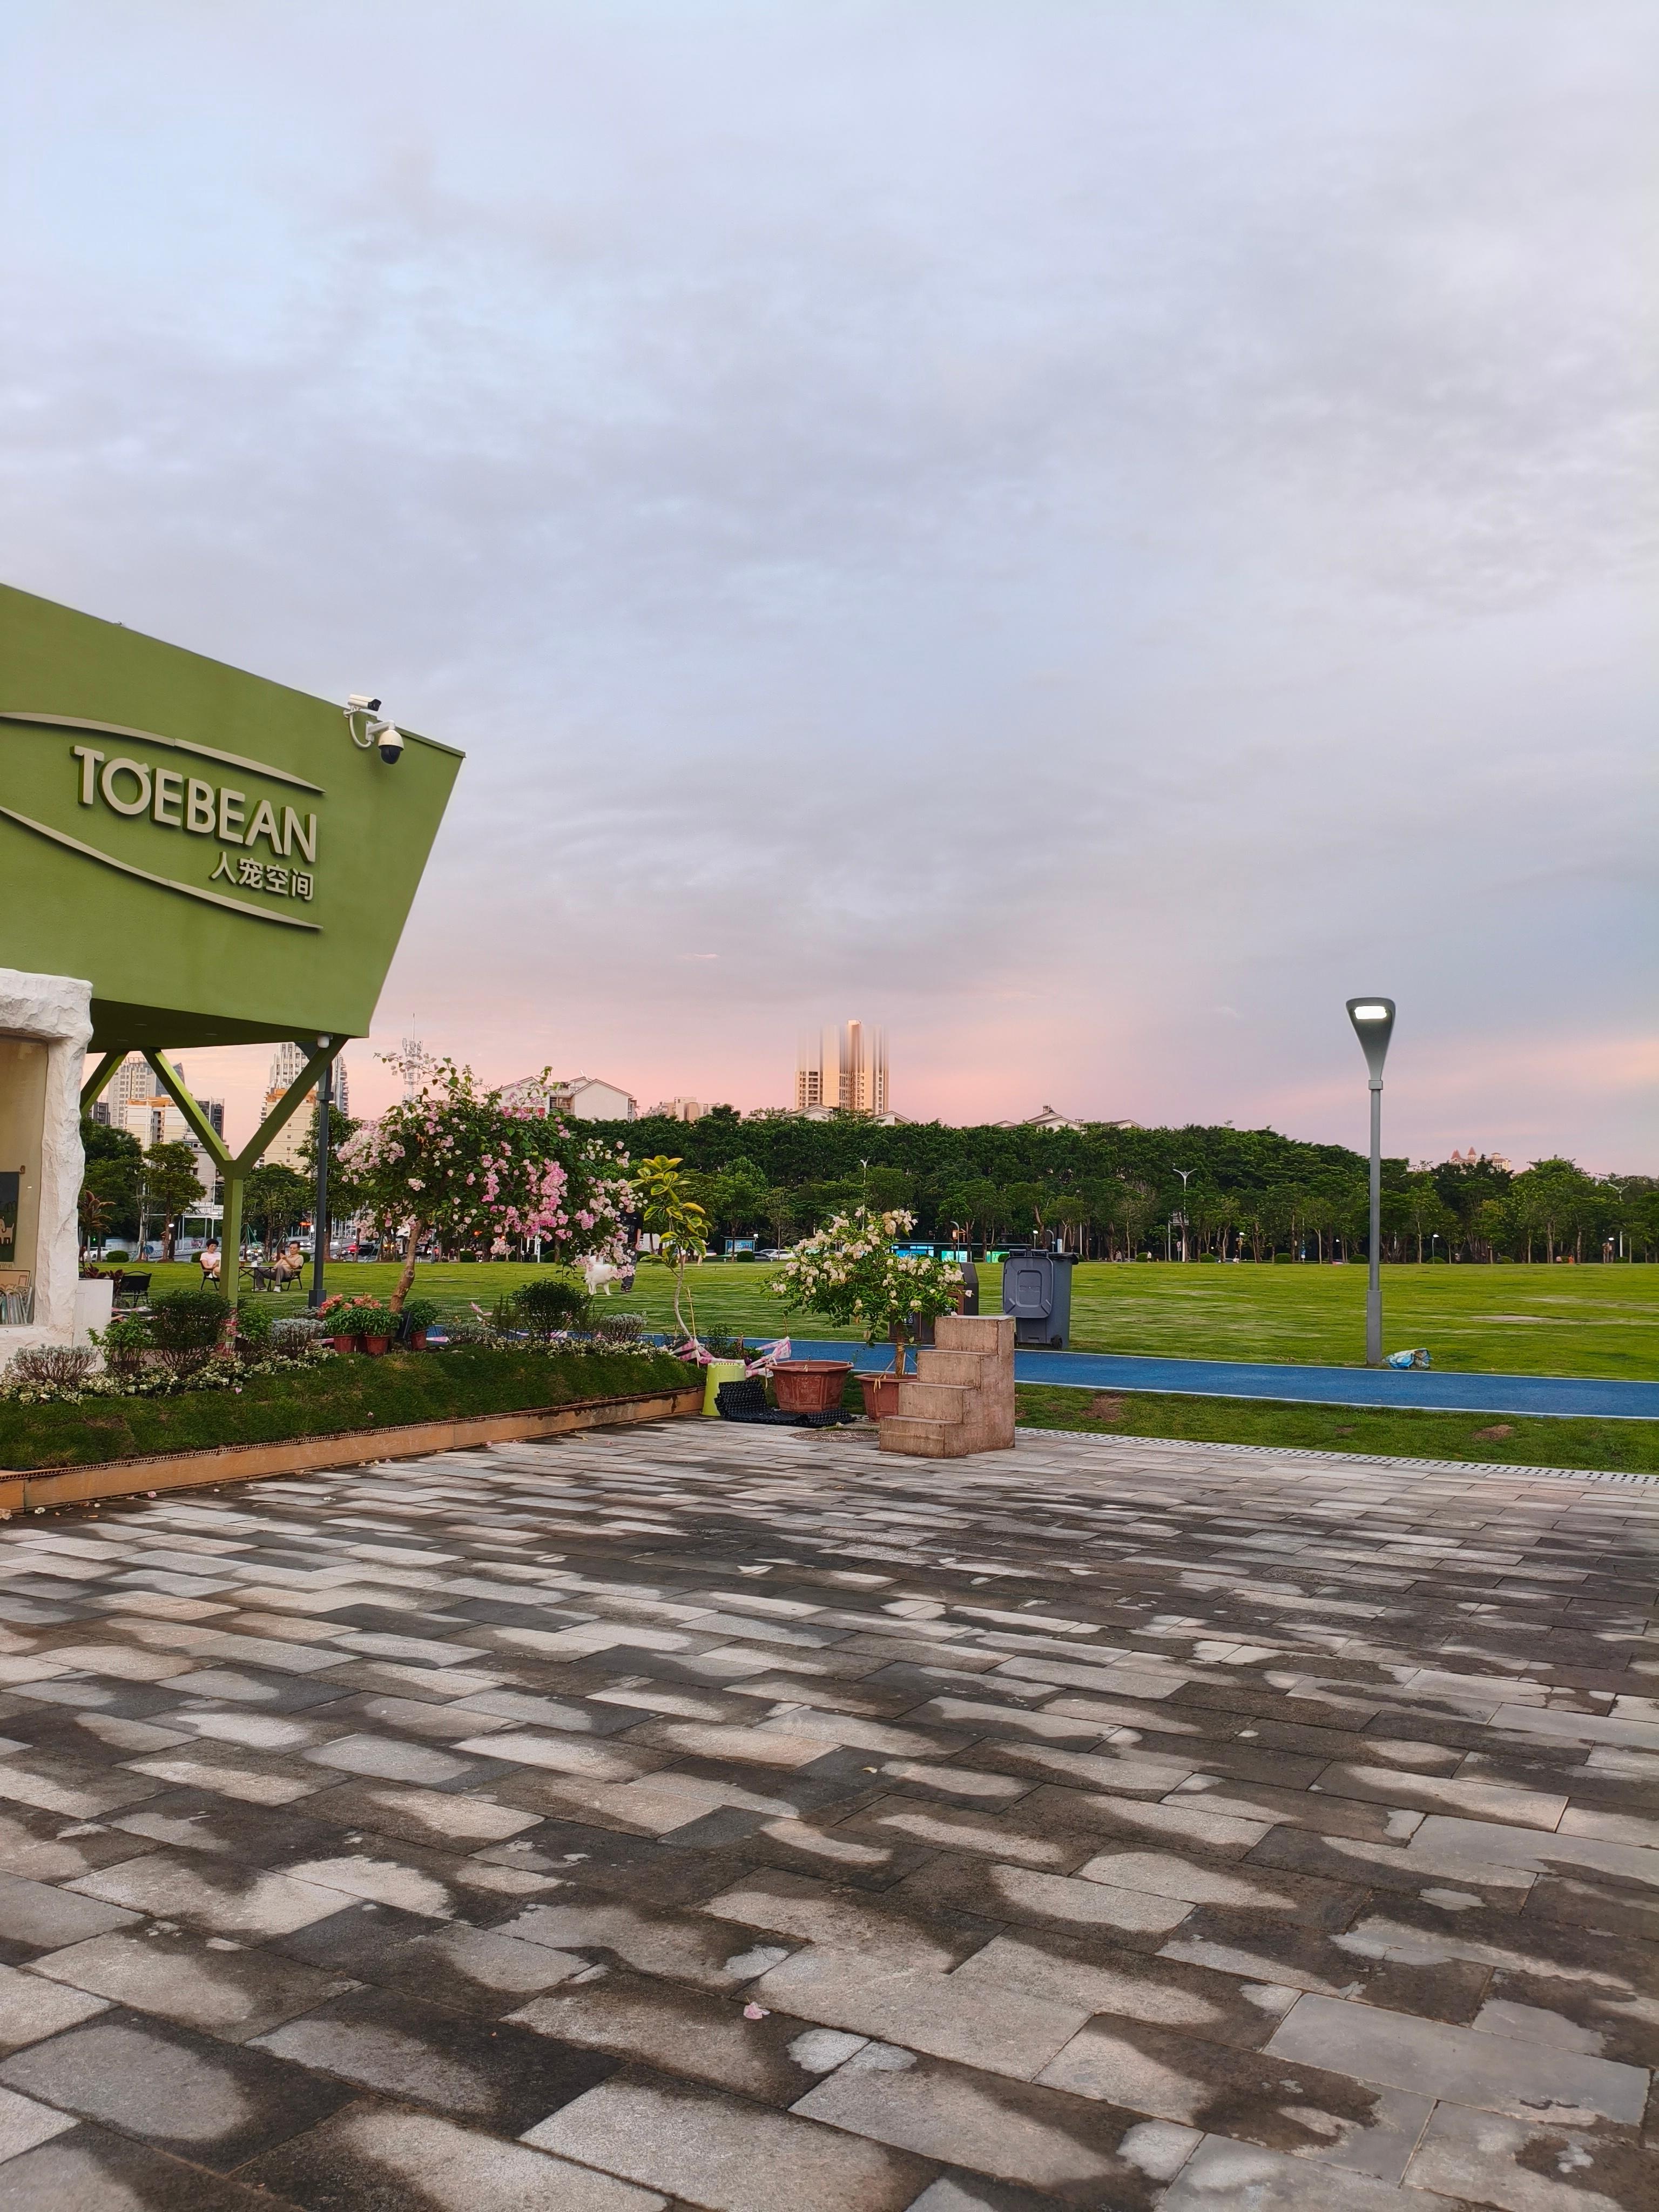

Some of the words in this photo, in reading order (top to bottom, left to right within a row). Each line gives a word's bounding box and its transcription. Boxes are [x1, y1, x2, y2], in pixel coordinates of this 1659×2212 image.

[71, 745, 316, 862] TOEBEAN
[210, 851, 313, 900] 人宠空间
